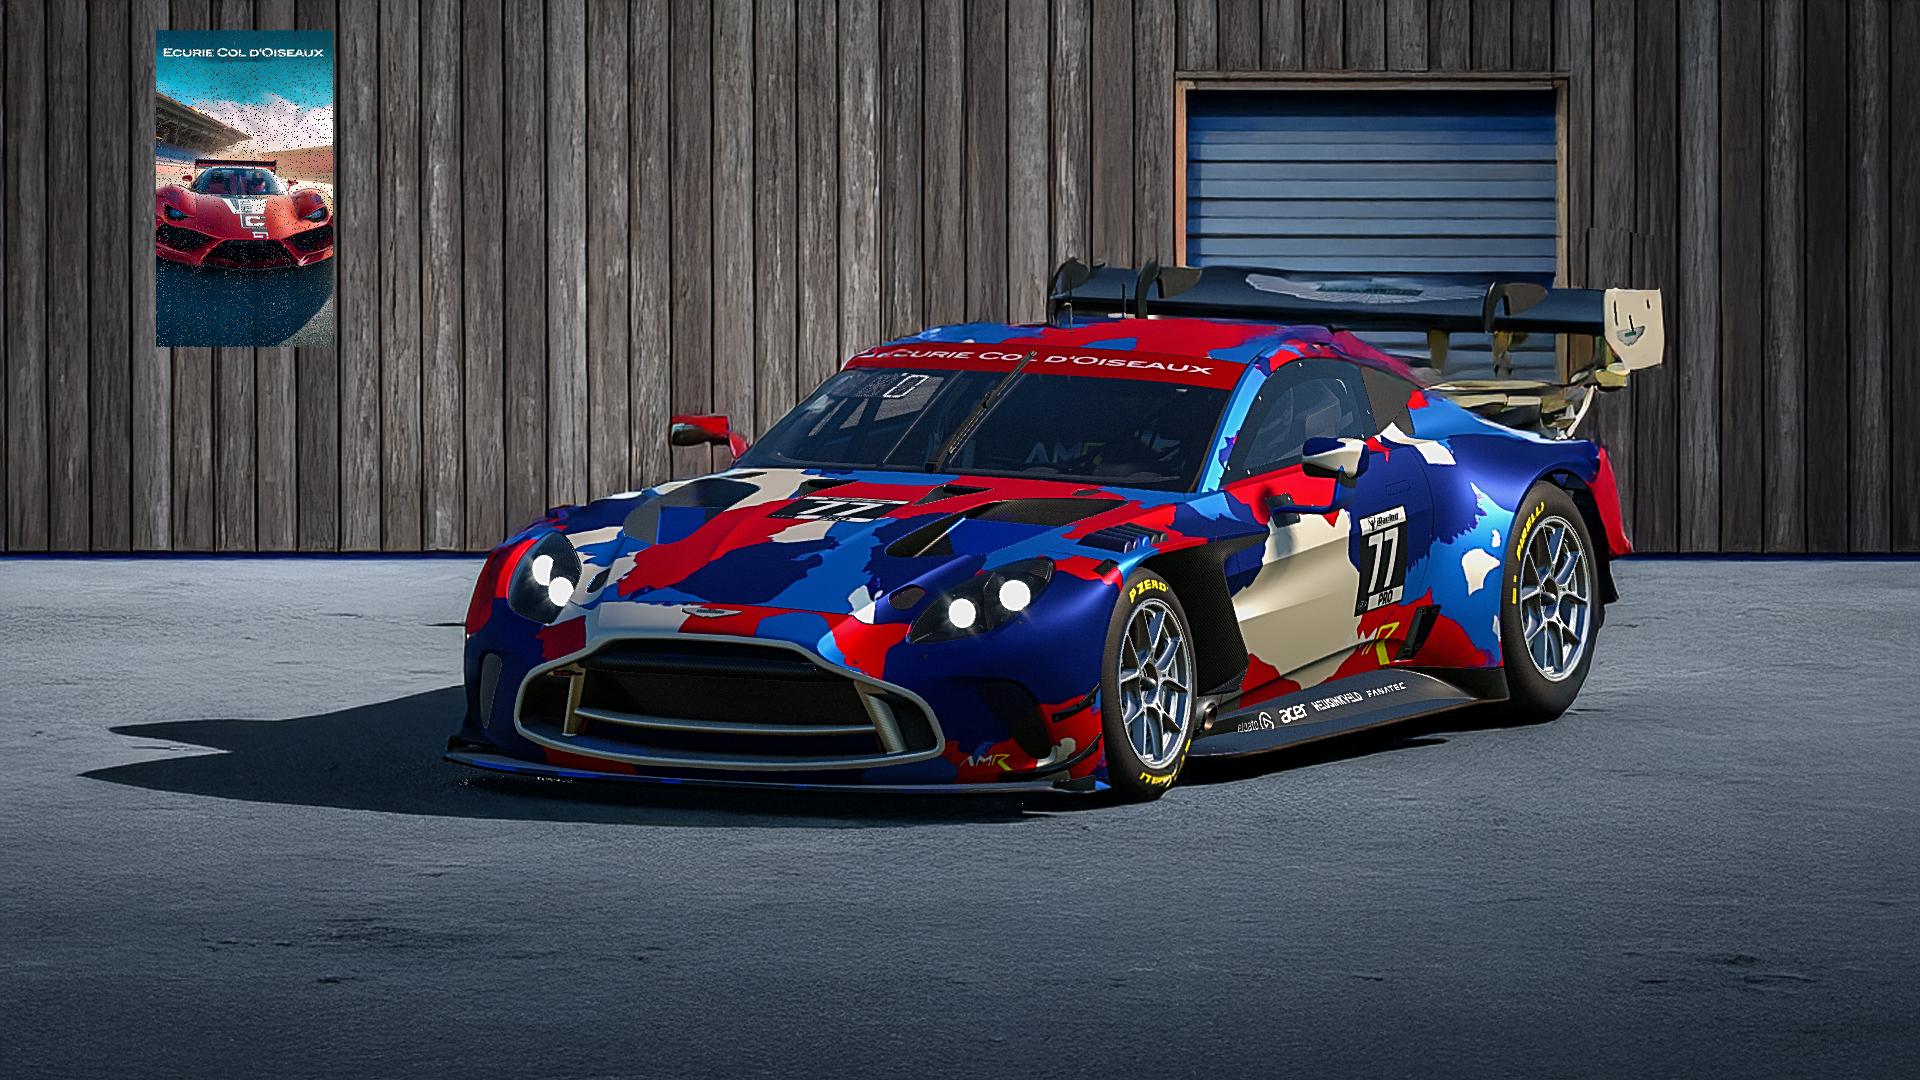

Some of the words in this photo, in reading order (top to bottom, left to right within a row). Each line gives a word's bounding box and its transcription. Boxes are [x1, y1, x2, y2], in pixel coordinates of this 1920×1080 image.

[163, 48, 214, 57] ECURIE
[217, 48, 247, 57] COL
[797, 501, 885, 516] 77
[1367, 526, 1399, 594] 77
[1377, 590, 1394, 607] PRO
[1279, 703, 1308, 724] acer
[1365, 682, 1407, 698] FANATEC
[960, 754, 1012, 771] AMR
